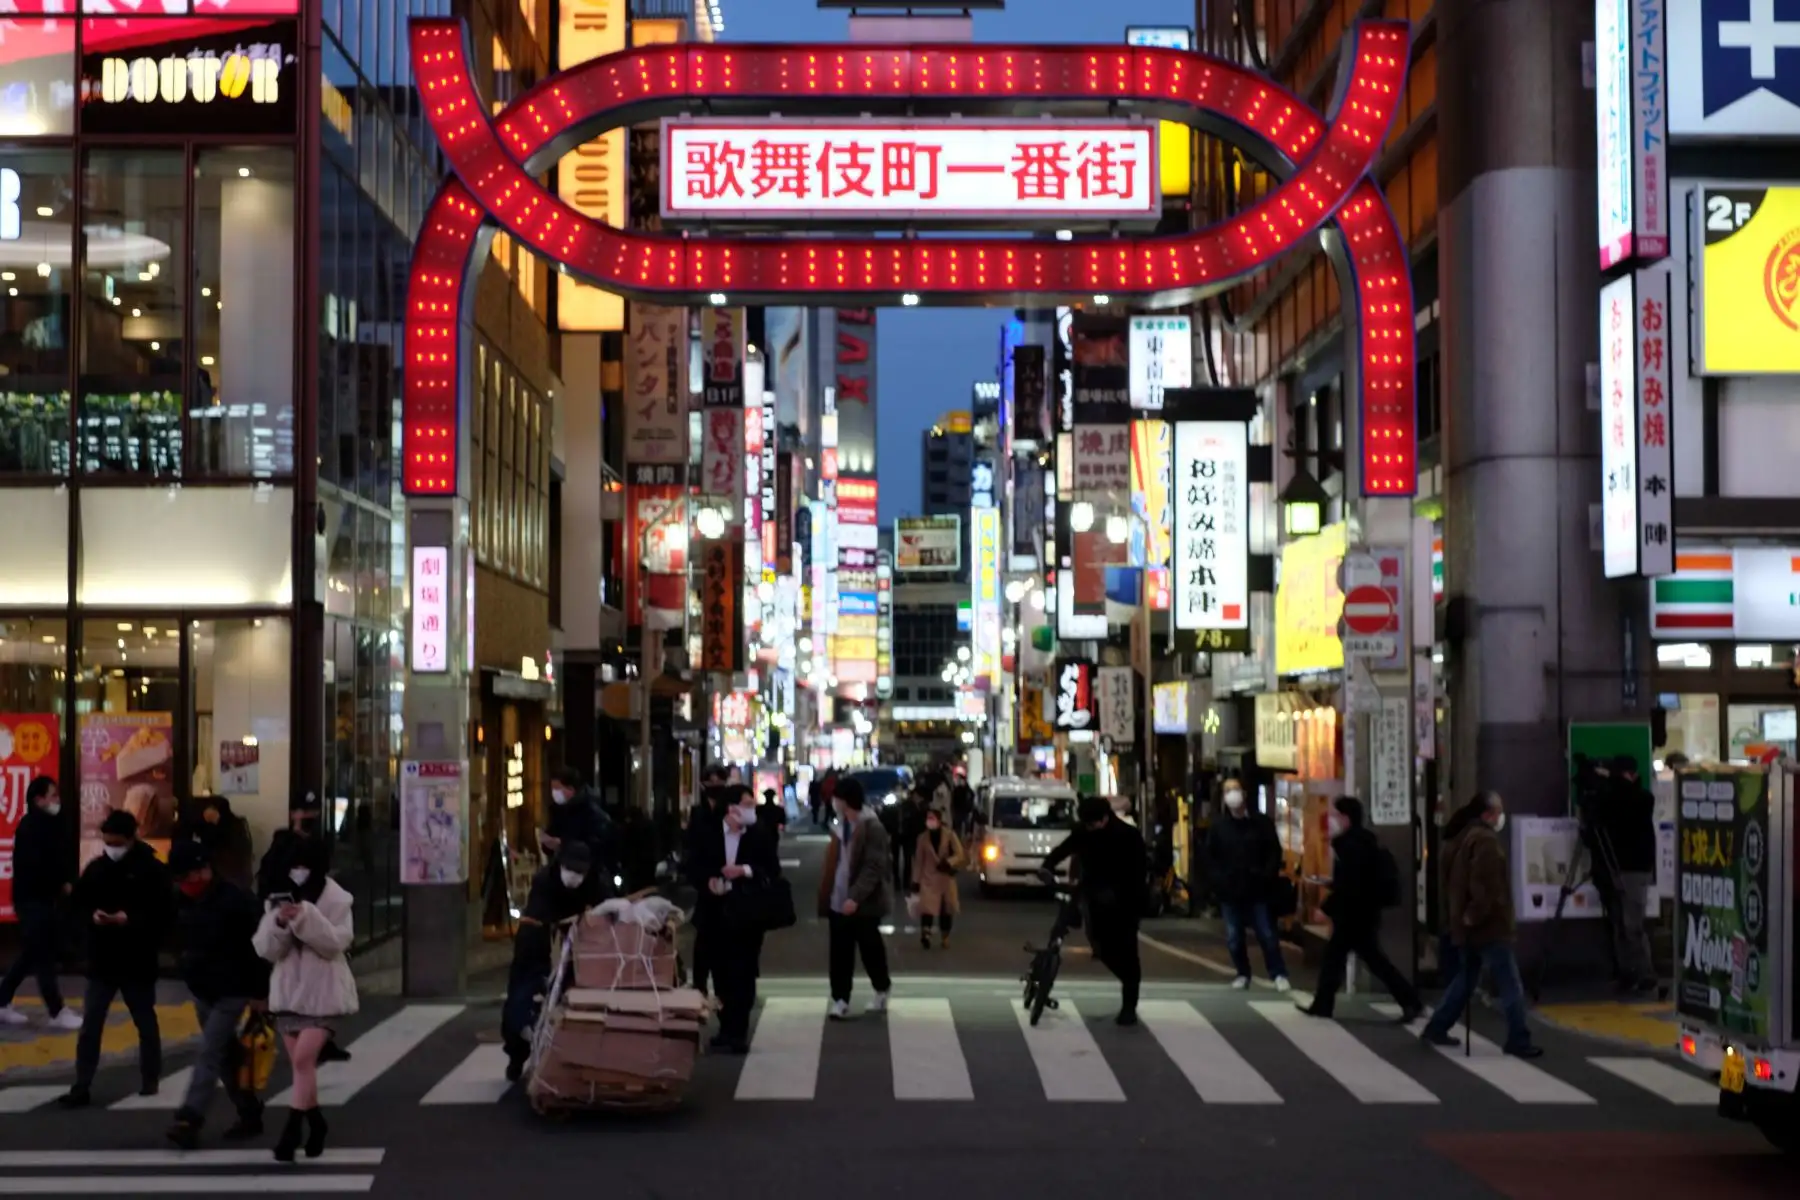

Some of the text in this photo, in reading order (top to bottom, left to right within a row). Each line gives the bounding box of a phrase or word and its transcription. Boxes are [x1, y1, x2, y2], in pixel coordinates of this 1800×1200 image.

[102, 55, 279, 103] DOUTOR
[685, 139, 1137, 200] 歌舞伎町一番街
[1707, 195, 1751, 231] 2F
[1641, 298, 1668, 546] お好み焼 本陣
[421, 557, 440, 659] 劇場通り
